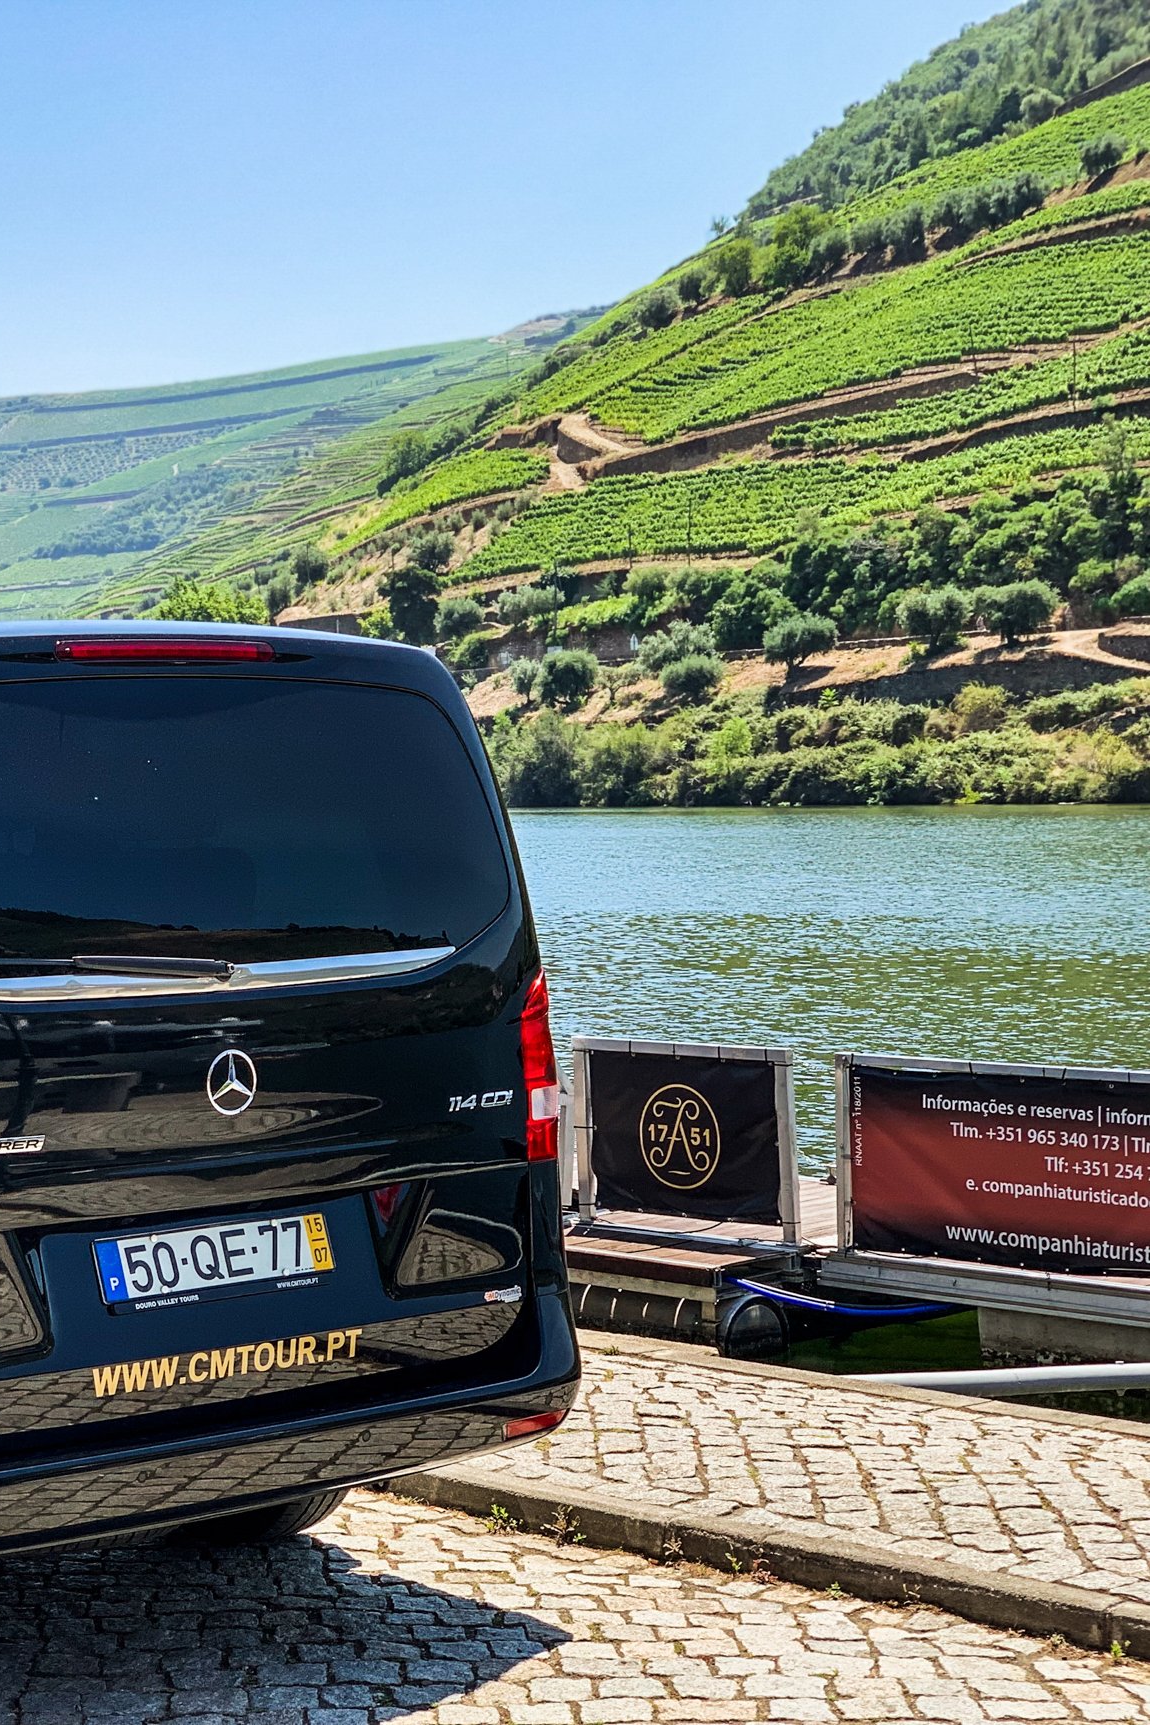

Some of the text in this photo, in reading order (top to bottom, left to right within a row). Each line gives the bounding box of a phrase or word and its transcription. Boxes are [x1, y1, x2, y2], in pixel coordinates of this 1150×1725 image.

[449, 1090, 513, 1112] 114 CDI
[853, 1076, 862, 1116] 118/2011
[922, 1094, 1014, 1117] Informações
[1017, 1104, 1027, 1116] e
[1030, 1105, 1094, 1122] reservas
[648, 1123, 669, 1142] 17
[690, 1127, 710, 1147] 51
[950, 1122, 983, 1139] Tlm.
[986, 1126, 1022, 1142] +351
[1027, 1128, 1056, 1145] 965
[1059, 1131, 1088, 1148] 340
[1092, 1134, 1120, 1151] 173
[855, 1132, 863, 1167] RNAAT
[1044, 1156, 1069, 1173] Tlf:
[1072, 1160, 1109, 1177] +351
[1114, 1163, 1144, 1180] 254
[965, 1178, 1150, 1209] e. companhiaturisticado
[306, 1217, 323, 1234] 15
[314, 1247, 329, 1264] 07
[109, 1276, 120, 1291] P
[275, 1277, 320, 1289] WWW.CMTOUR.PT
[135, 1294, 200, 1311] DOURO VALLEY TOURS
[92, 1329, 363, 1398] WWW.CMTOUR.PT
